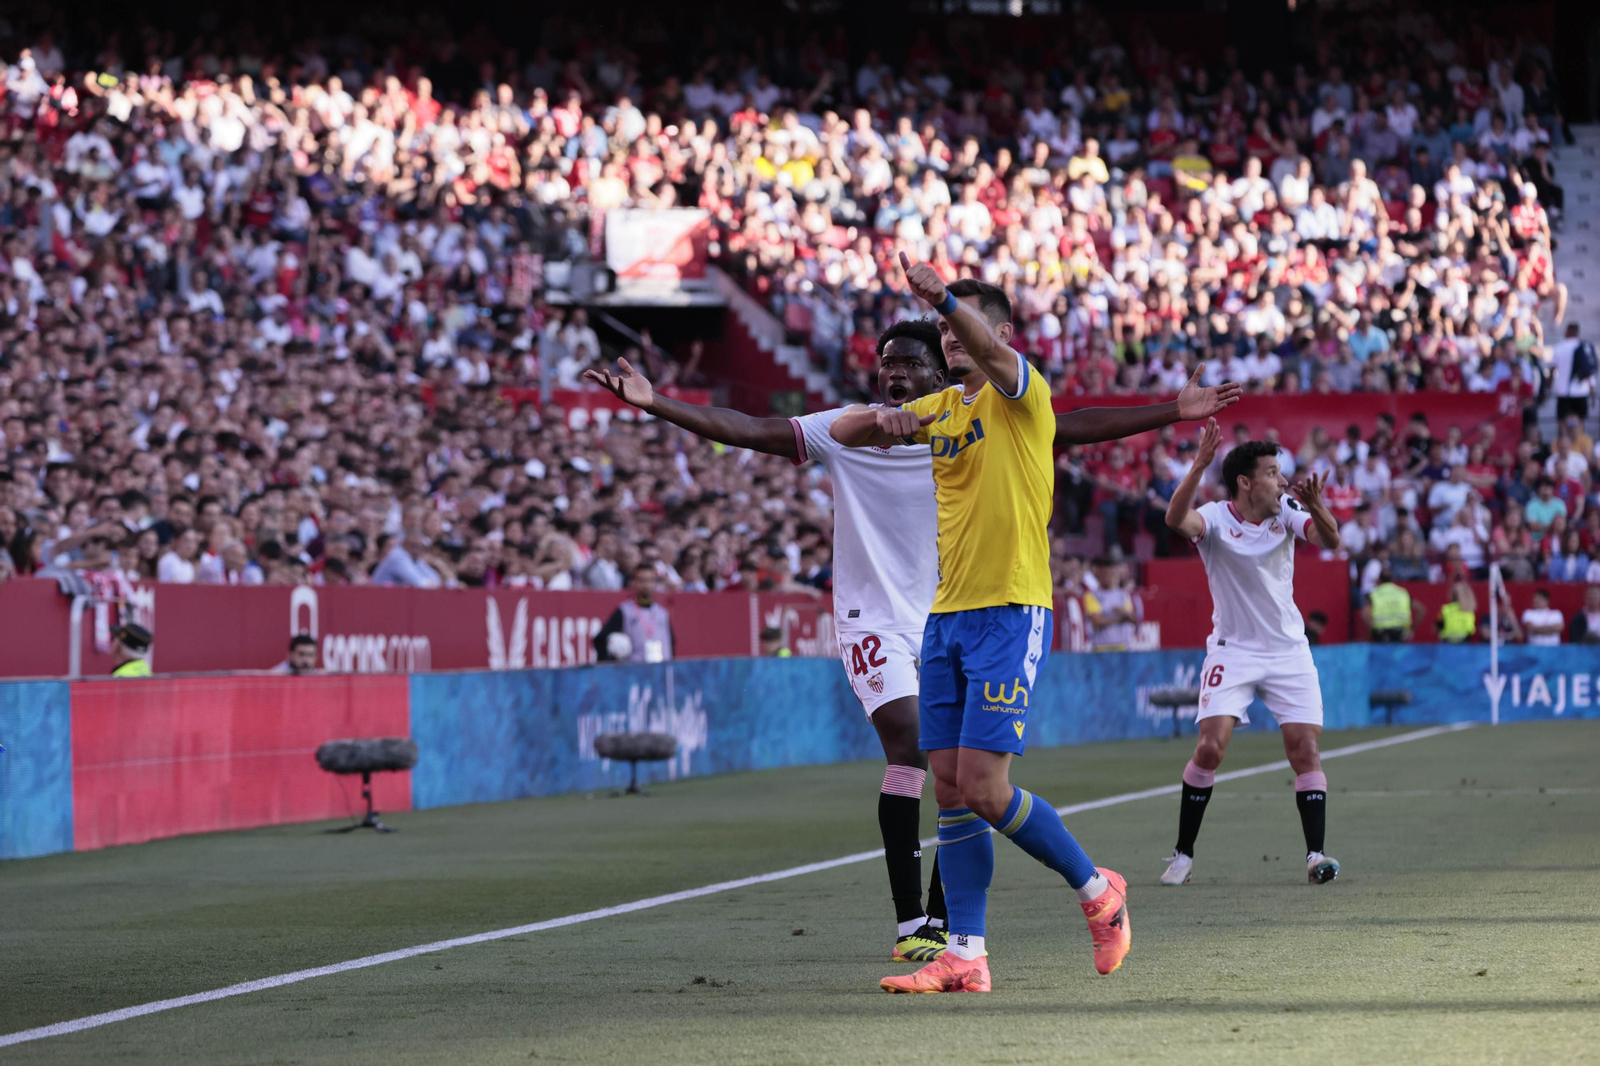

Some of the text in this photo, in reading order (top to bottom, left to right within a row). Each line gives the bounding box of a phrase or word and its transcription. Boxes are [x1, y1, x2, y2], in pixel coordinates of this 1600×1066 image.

[852, 635, 887, 676] 42
[1203, 664, 1224, 690] 16
[1483, 673, 1600, 715] VIAJE
